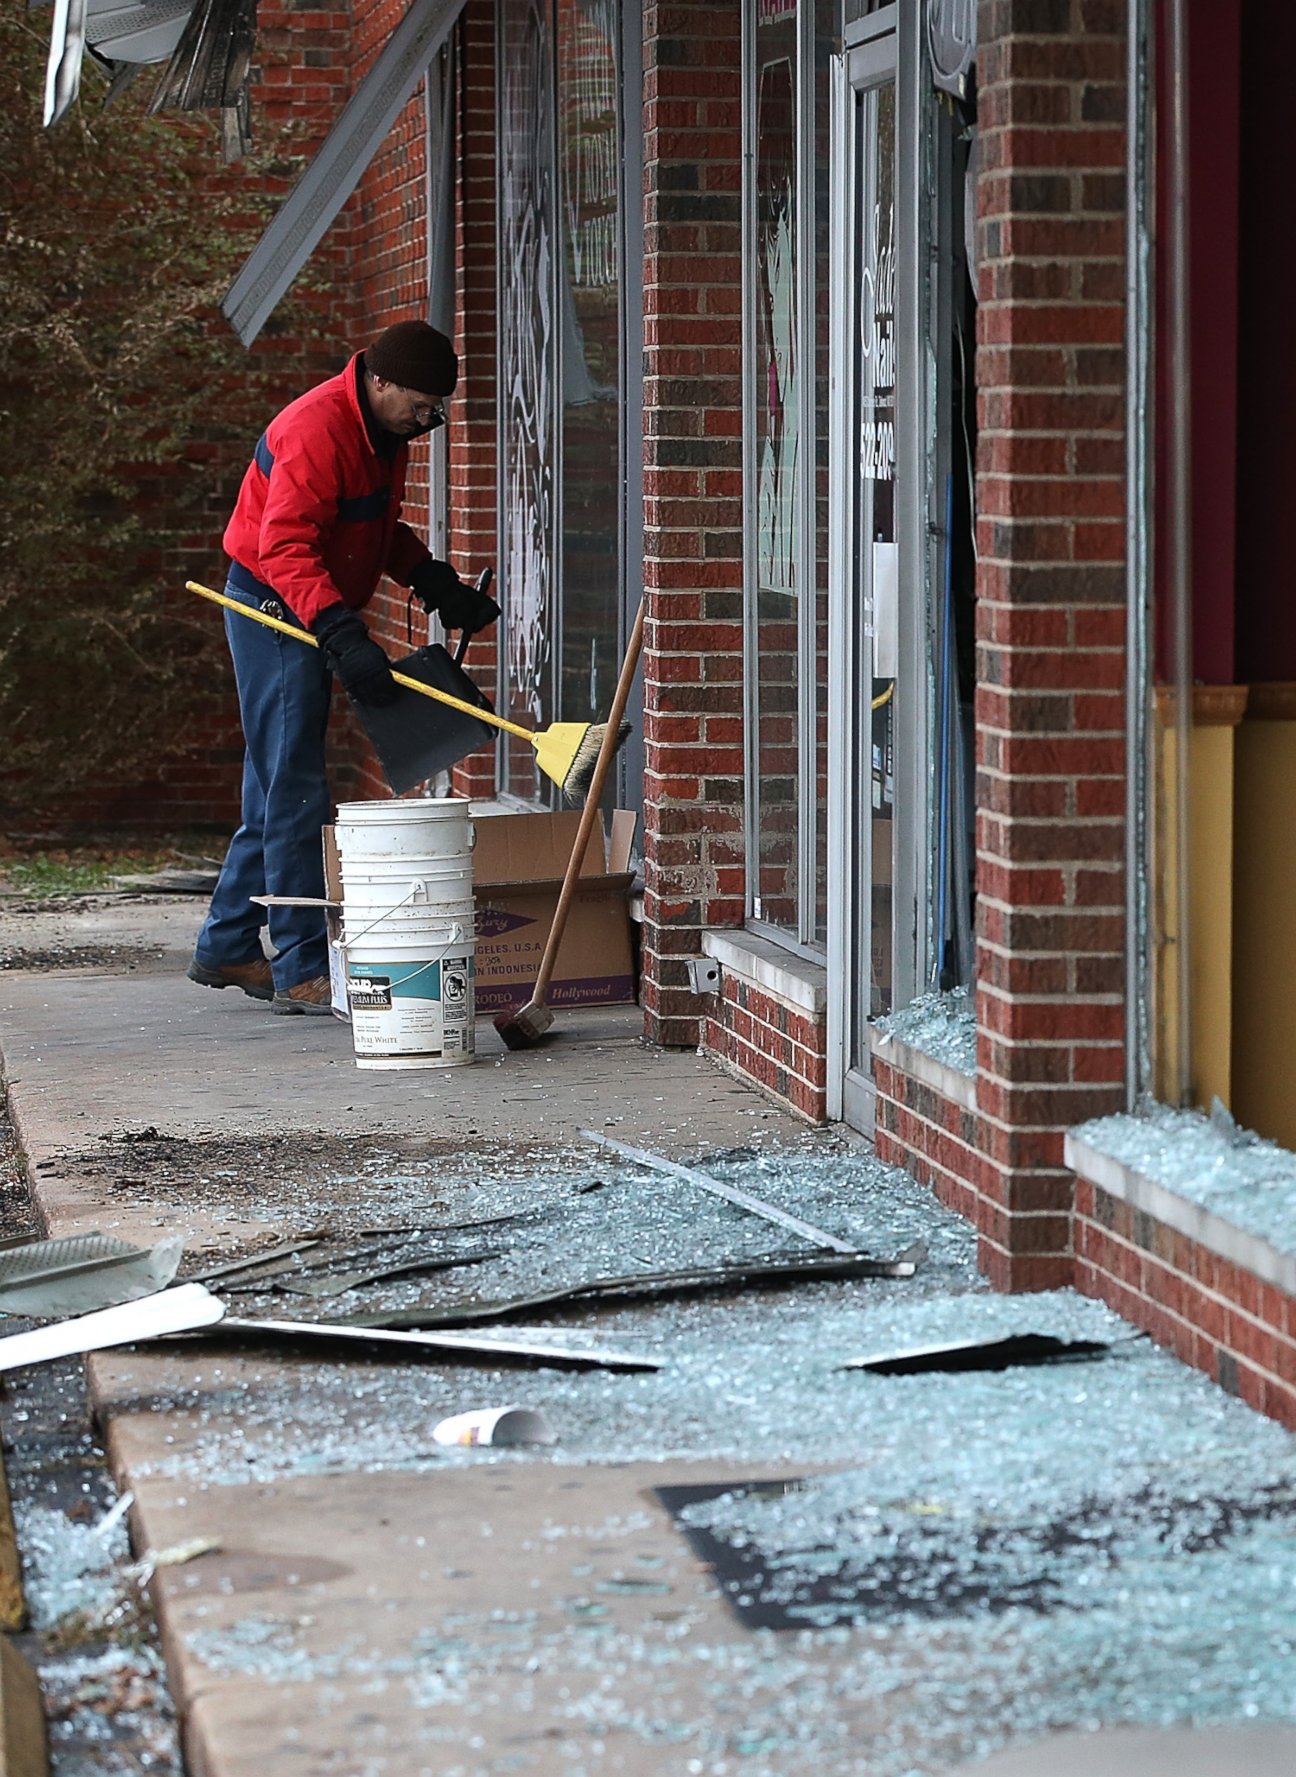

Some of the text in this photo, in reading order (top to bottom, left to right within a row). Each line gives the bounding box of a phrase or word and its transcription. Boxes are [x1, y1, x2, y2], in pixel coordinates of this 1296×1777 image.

[584, 129, 617, 204] ROYAL
[584, 213, 618, 286] TOUCH
[475, 944, 512, 955] GELES.
[552, 985, 611, 1001] Hollywood
